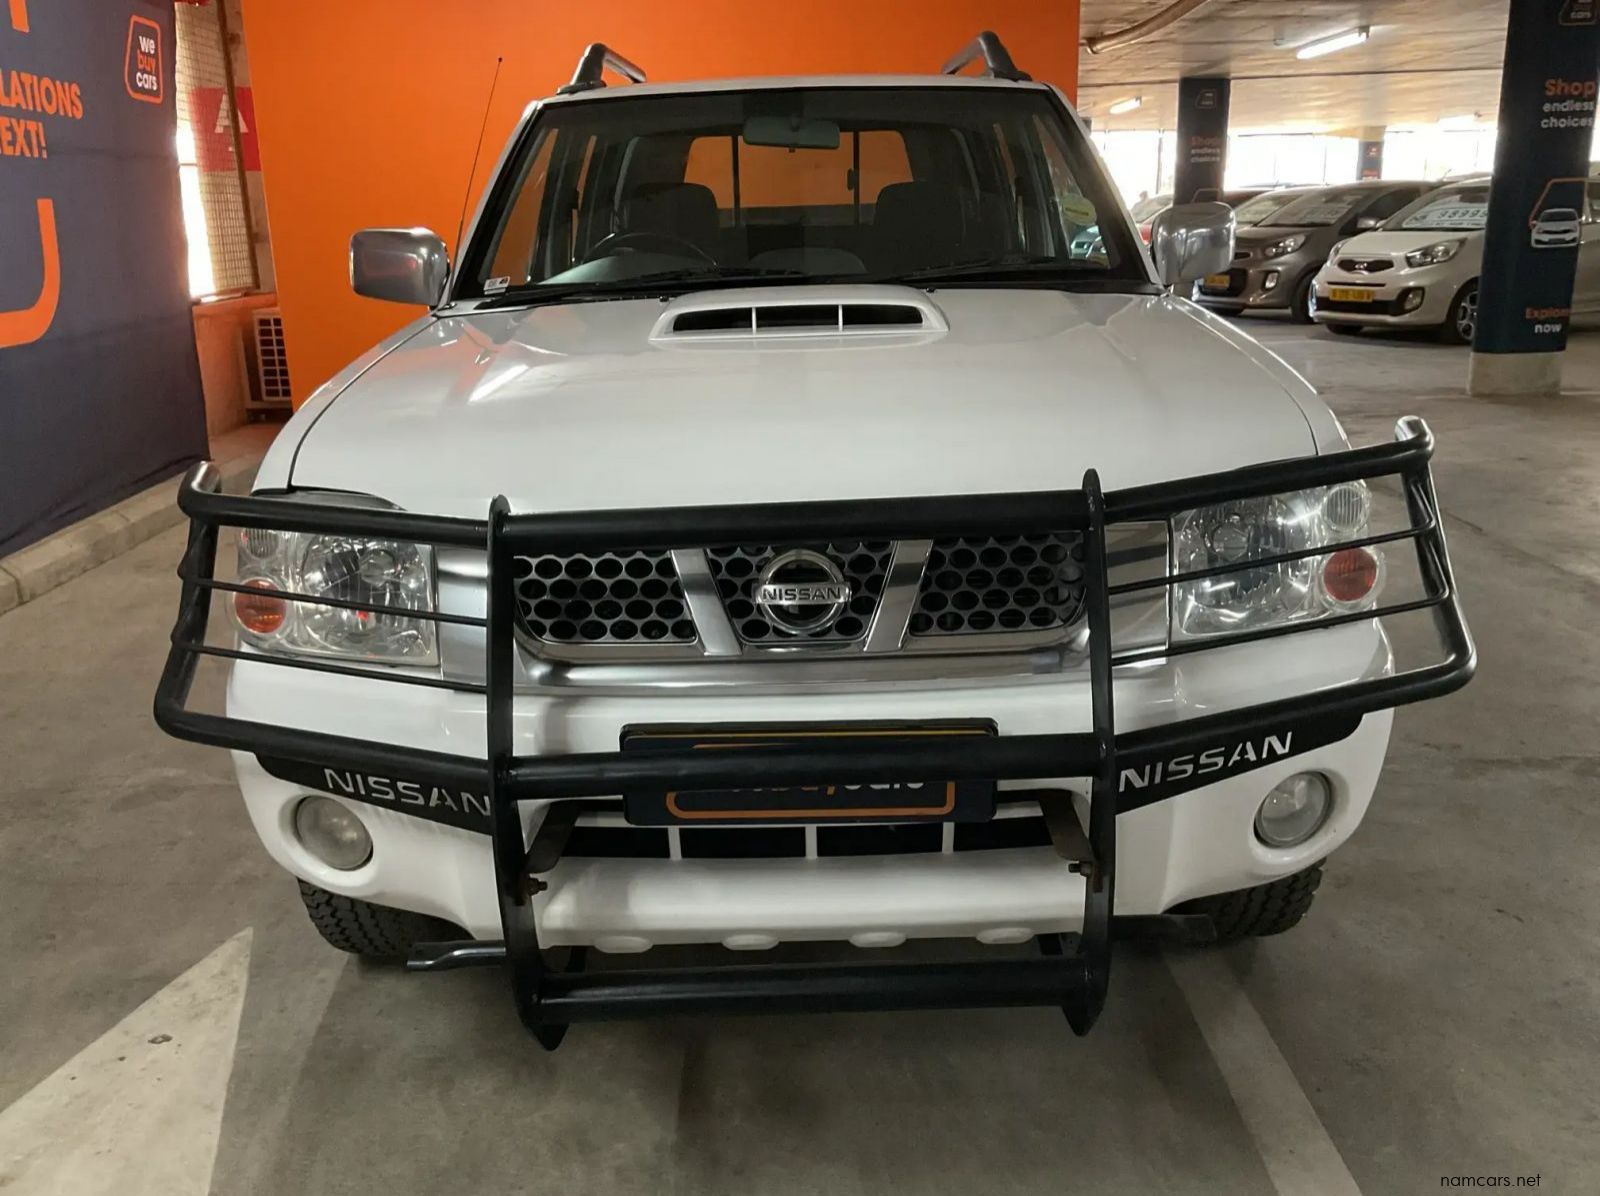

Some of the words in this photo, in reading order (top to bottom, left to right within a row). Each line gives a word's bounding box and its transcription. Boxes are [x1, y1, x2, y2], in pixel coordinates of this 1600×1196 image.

[138, 35, 156, 55] we
[136, 48, 156, 74] buy
[136, 72, 158, 91] cars
[1544, 79, 1596, 98] Shop
[0, 68, 83, 119] LATIONS
[1542, 100, 1594, 112] endless
[1540, 116, 1593, 128] choices
[0, 116, 48, 159] EXT!
[1534, 323, 1562, 333] now
[762, 587, 840, 600] NISSAN
[1118, 731, 1293, 793] NISSAN
[323, 768, 491, 817] NISSAN
